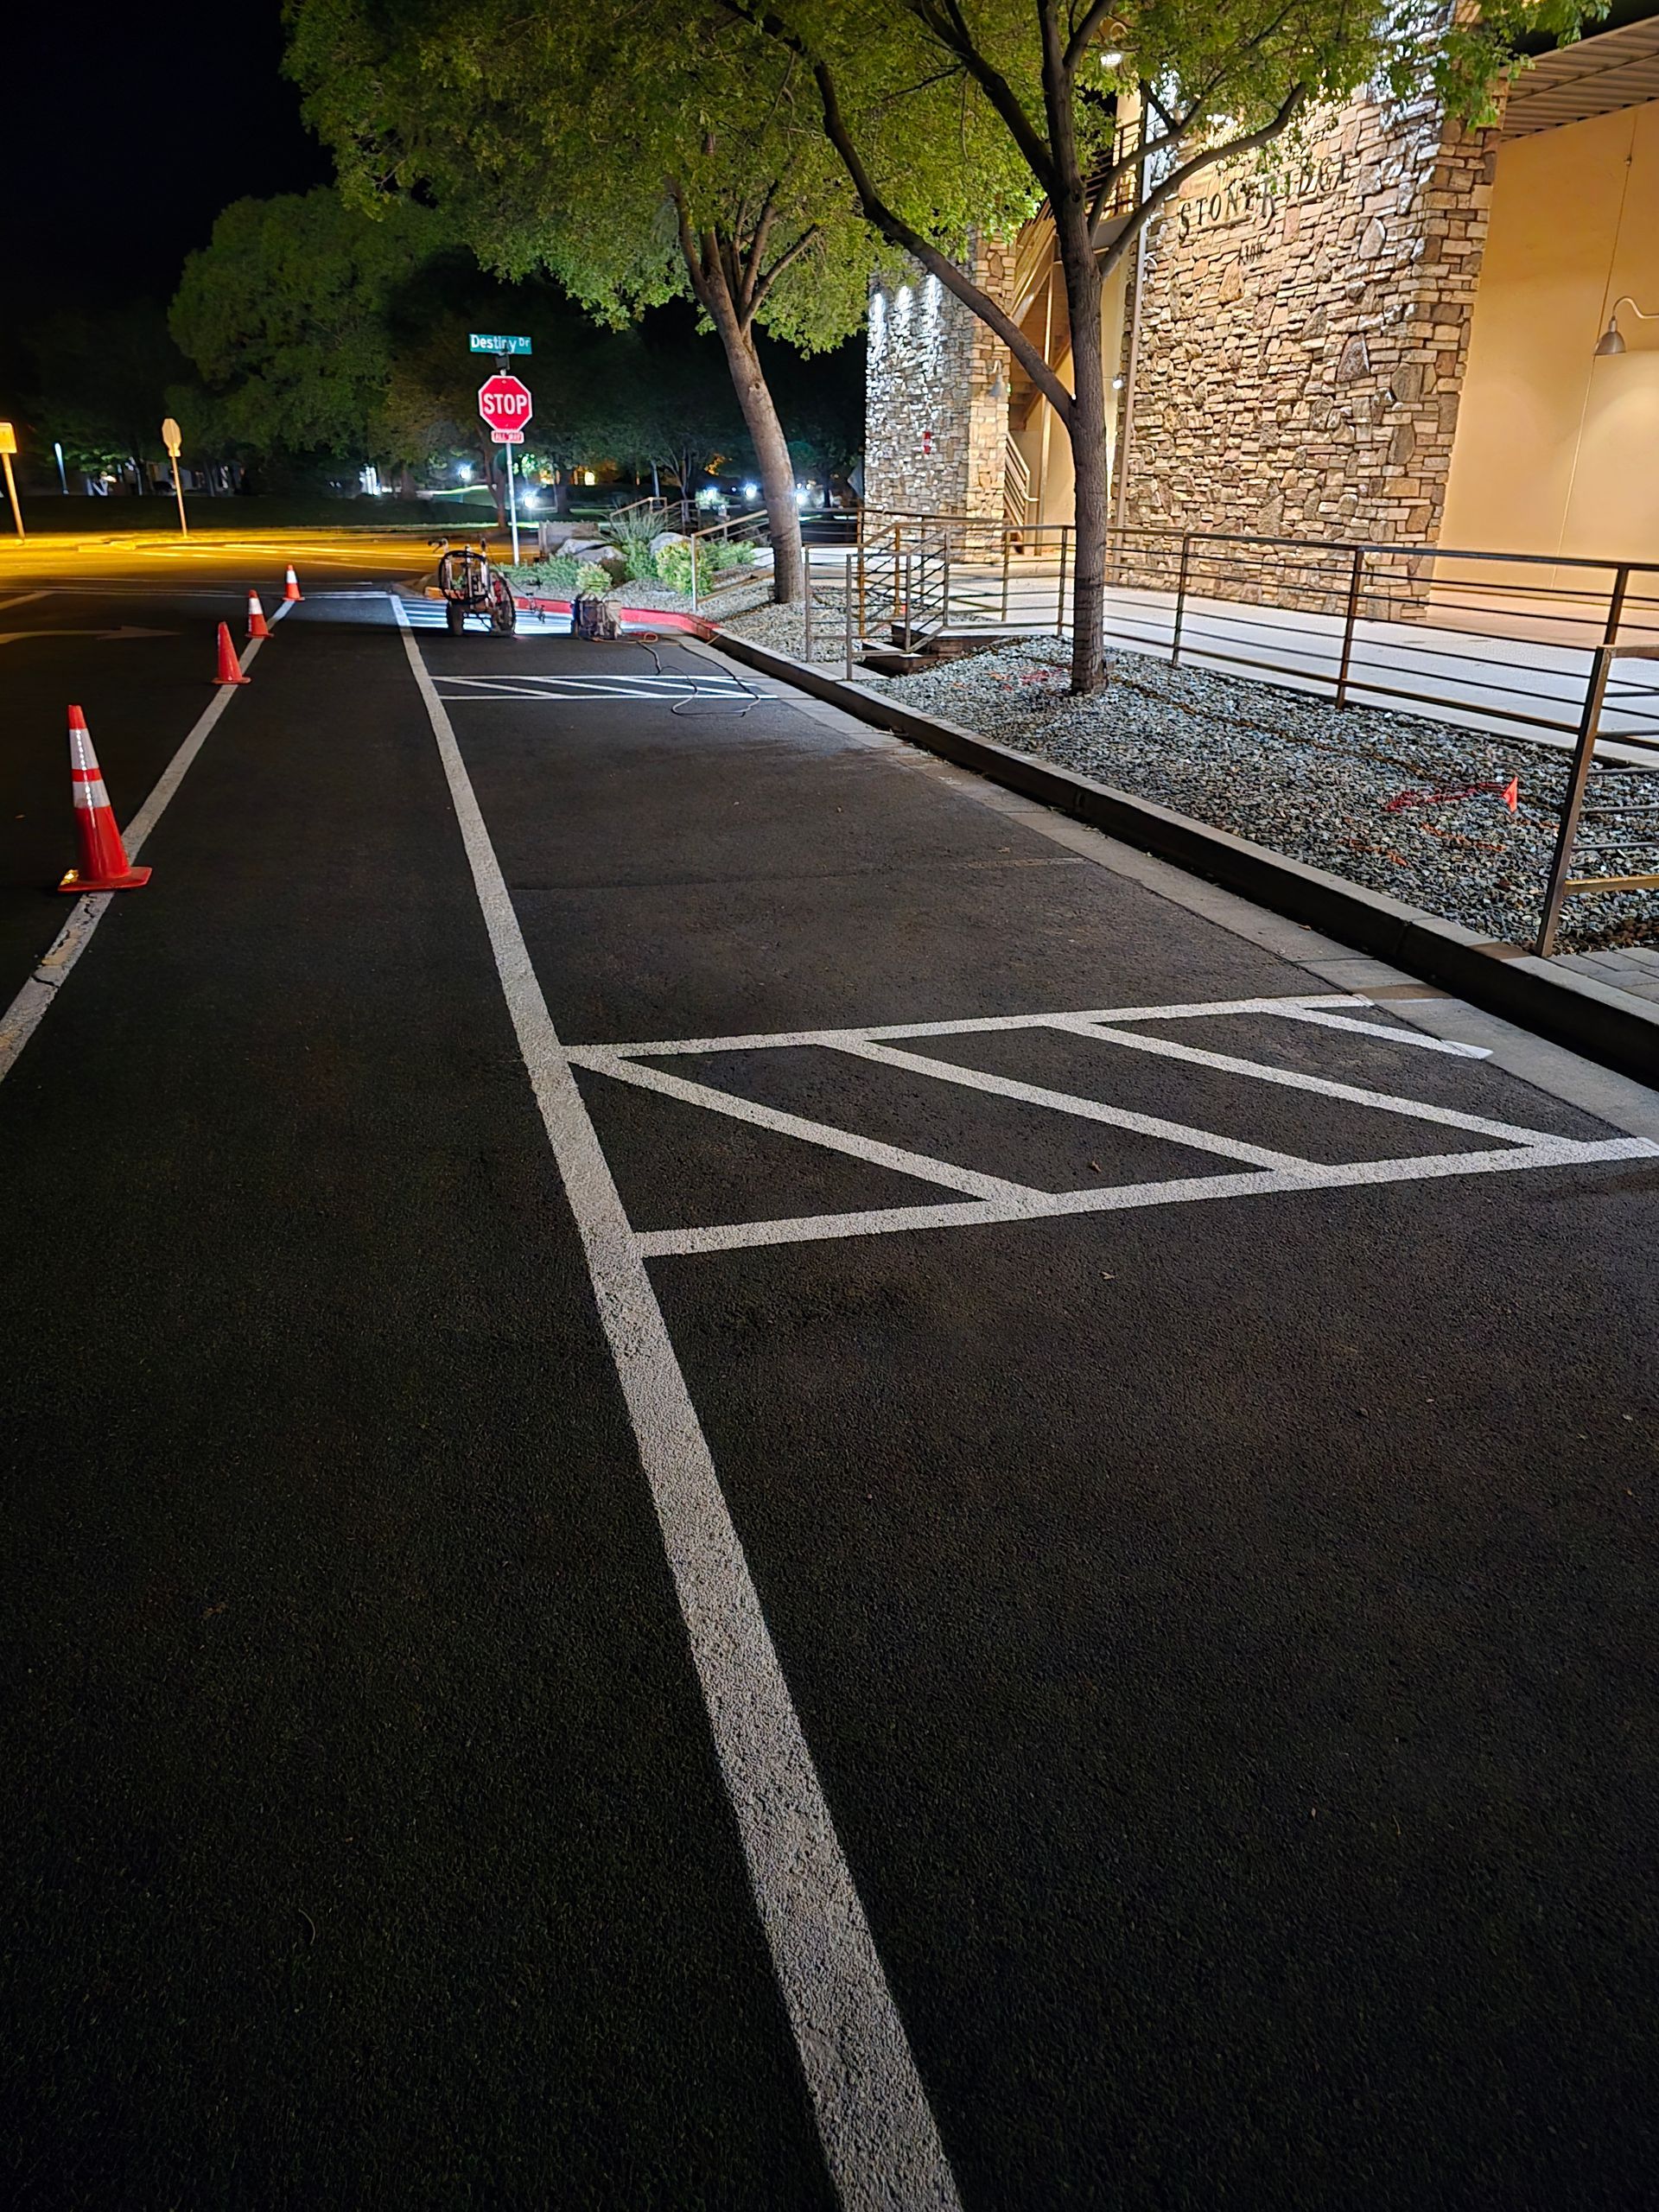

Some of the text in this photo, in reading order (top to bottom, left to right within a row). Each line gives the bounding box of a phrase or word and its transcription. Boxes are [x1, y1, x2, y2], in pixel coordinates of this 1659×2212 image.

[471, 334, 530, 353] Destiny Dr
[483, 393, 528, 415] STOP
